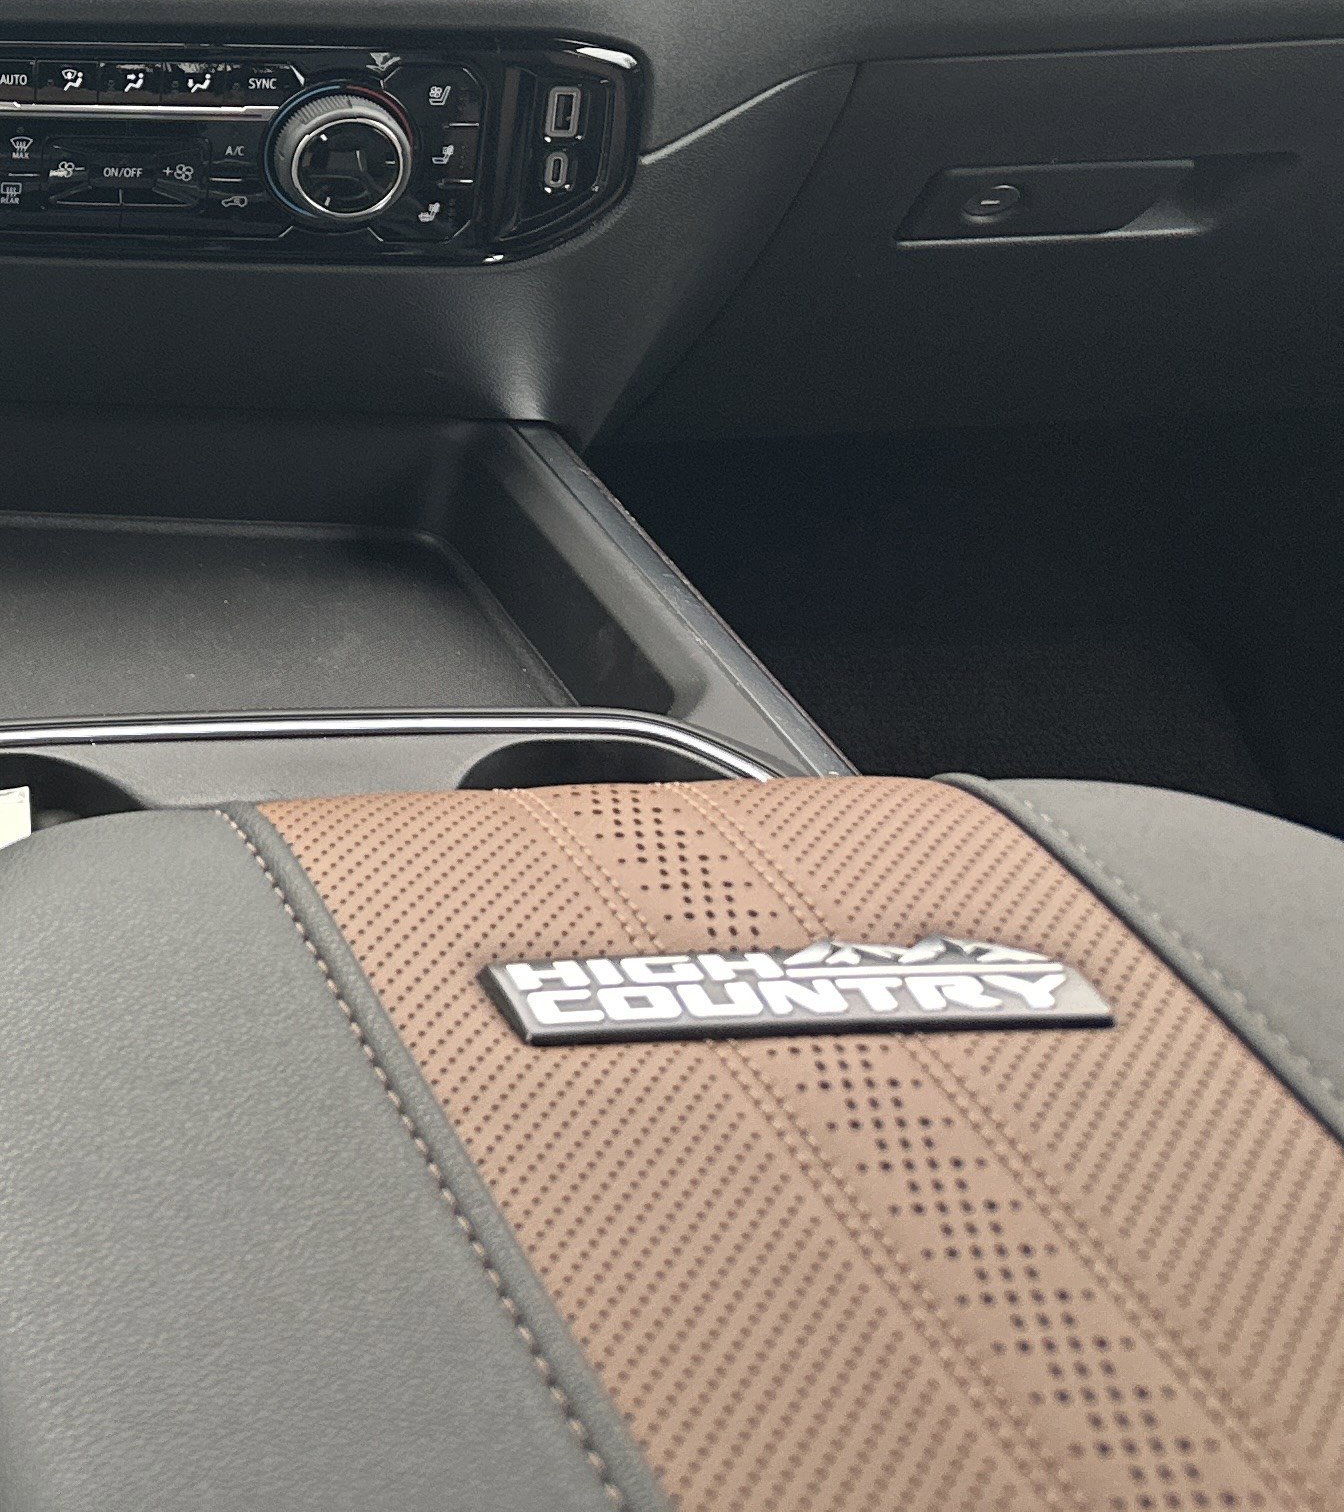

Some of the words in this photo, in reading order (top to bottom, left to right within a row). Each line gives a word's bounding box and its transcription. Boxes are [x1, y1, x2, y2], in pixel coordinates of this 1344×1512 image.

[0, 74, 28, 86] AUTO
[248, 77, 278, 90] SYNC
[224, 144, 245, 157] A/C
[103, 166, 144, 178] ON/OFF
[0, 196, 20, 205] REAR
[505, 953, 787, 990] HIGH
[526, 972, 1068, 1025] COUNTRY
